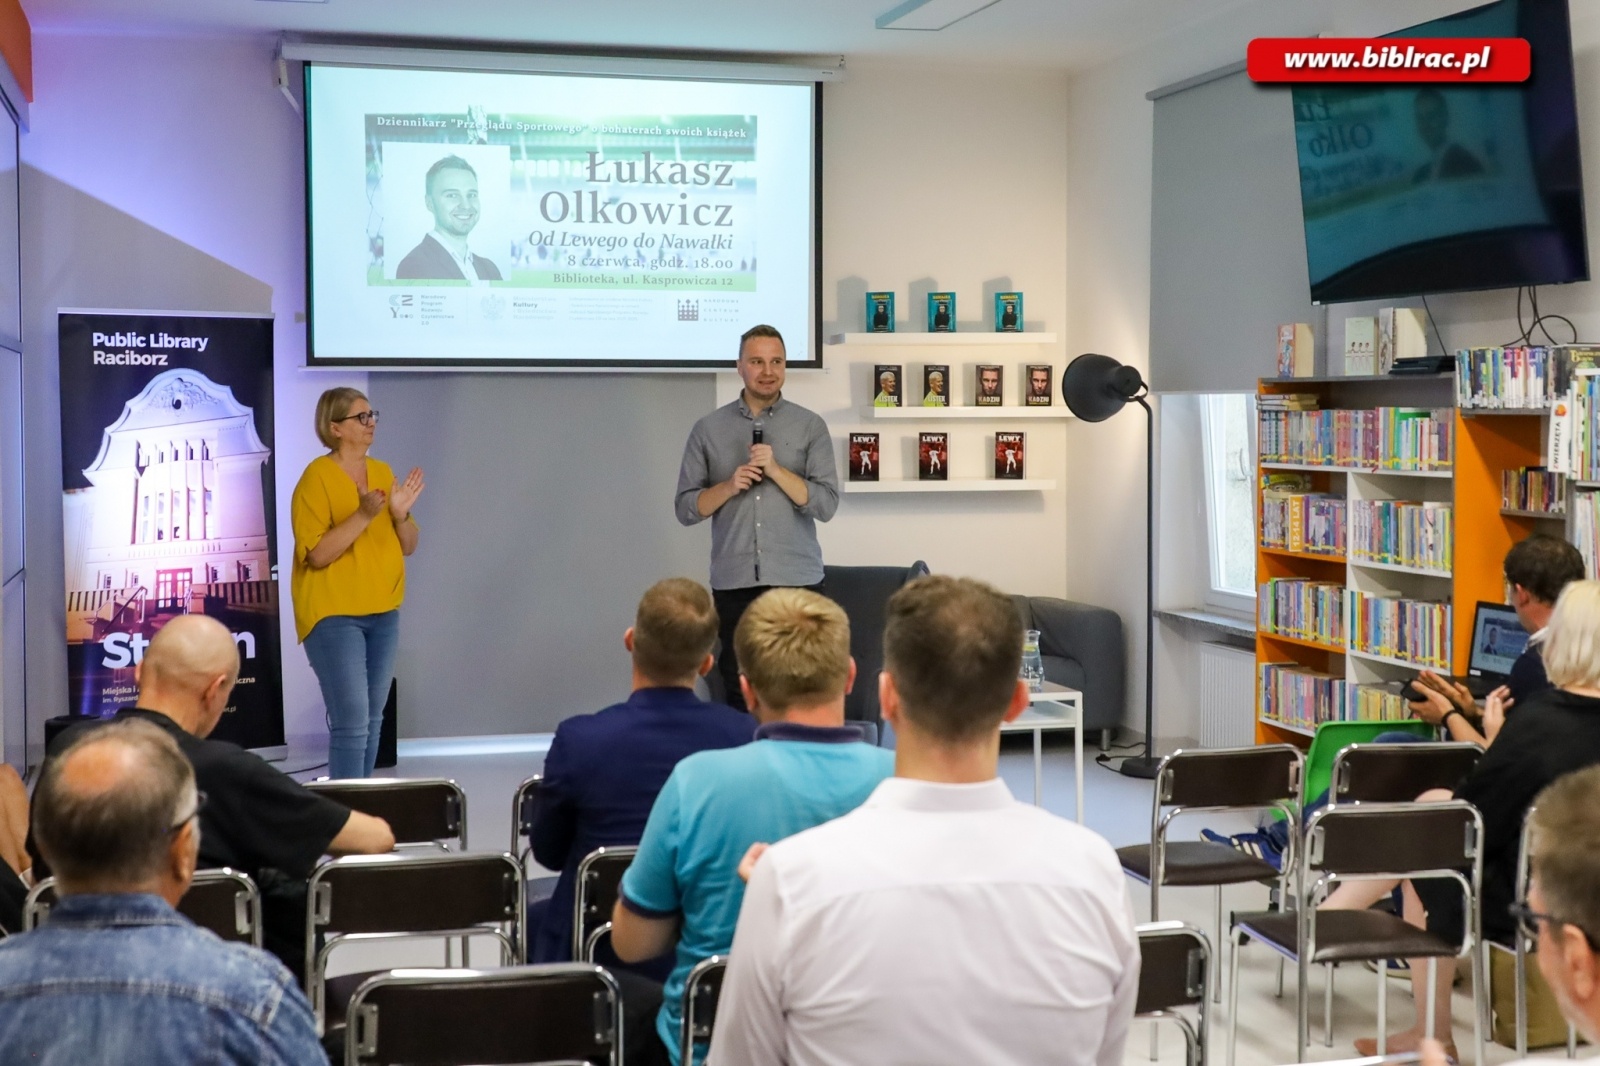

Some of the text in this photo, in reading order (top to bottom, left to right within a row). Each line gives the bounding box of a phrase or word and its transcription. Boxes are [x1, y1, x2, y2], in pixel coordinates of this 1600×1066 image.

[377, 116, 446, 128] Dziennikarz
[451, 119, 512, 131] "Przeglądu
[602, 124, 662, 135] bohaterach
[666, 126, 702, 136] swoich
[706, 128, 746, 138] książek
[586, 151, 733, 186] Łukasz
[540, 190, 734, 226] Olkowicz
[528, 230, 733, 252] Od Lewego do Nawałki
[568, 255, 733, 270] 8 czerwca, godz. 18.00
[553, 274, 618, 285] Biblioteka,
[622, 274, 638, 284] ul.
[642, 274, 717, 288] Kasprowicza
[92, 332, 208, 352] Public Library
[93, 350, 168, 366] Raciborz
[103, 687, 132, 695] Miejska
